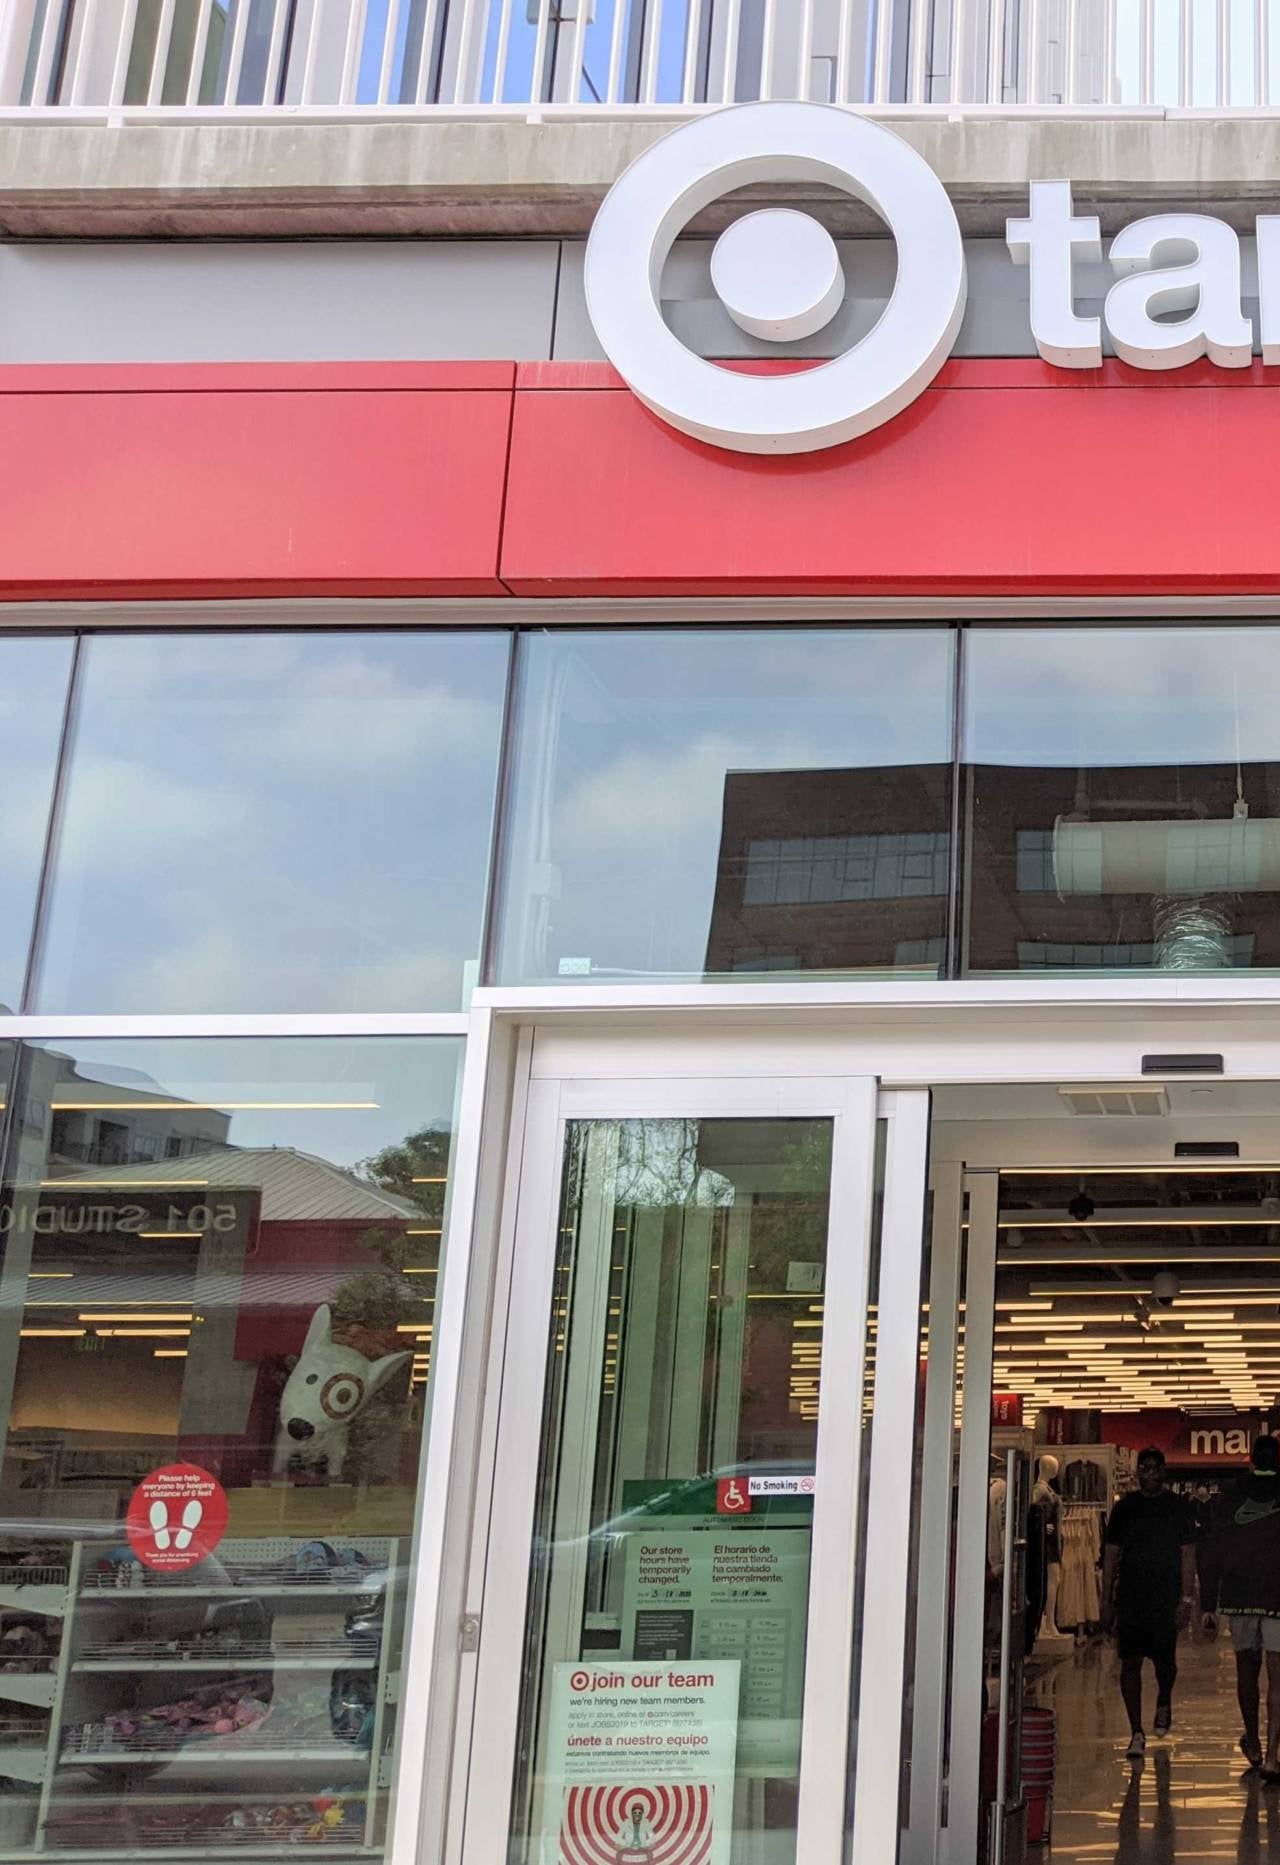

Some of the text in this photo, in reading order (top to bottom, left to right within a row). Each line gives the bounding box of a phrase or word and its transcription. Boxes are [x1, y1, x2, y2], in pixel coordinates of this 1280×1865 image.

[158, 1474, 201, 1483] Please help
[186, 1482, 216, 1490] keeping
[750, 1480, 798, 1491] No Smoking
[150, 1490, 181, 1498] distance
[640, 1545, 683, 1555] Our store
[714, 1545, 771, 1554] El horario de
[639, 1556, 690, 1564] hours have
[713, 1554, 778, 1564] nuestra tienda
[639, 1565, 692, 1576] temporarily
[712, 1564, 771, 1573] ha cambiado
[638, 1575, 681, 1585] changed.
[712, 1574, 783, 1584] temporalmente.
[591, 1672, 714, 1692] join our team
[570, 1696, 705, 1707] we're hiring new team members.
[567, 1733, 709, 1748] únete a nuestro equipo
